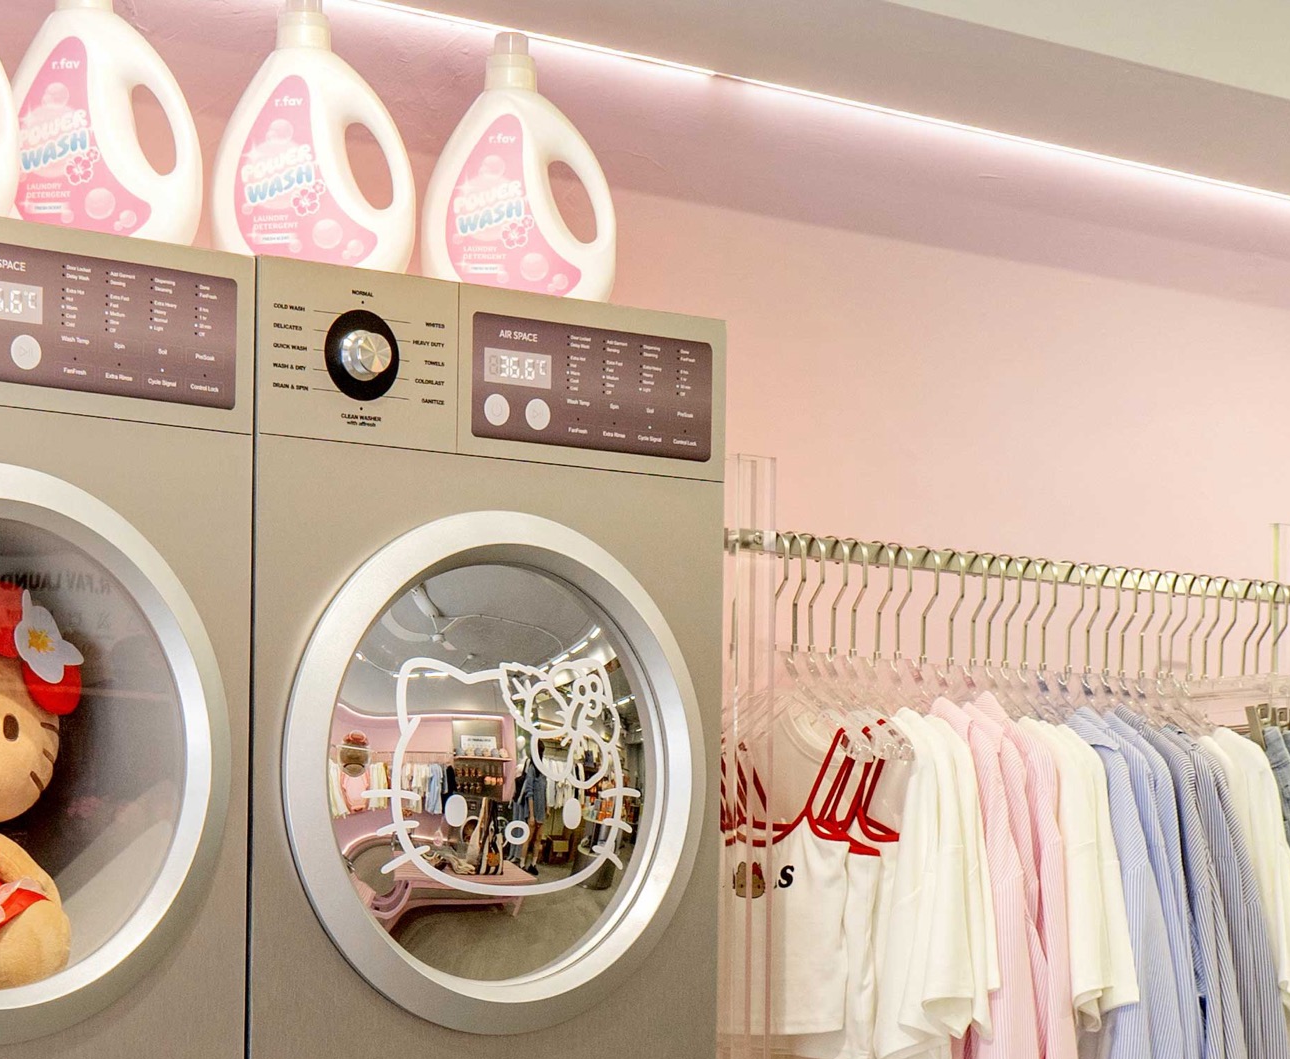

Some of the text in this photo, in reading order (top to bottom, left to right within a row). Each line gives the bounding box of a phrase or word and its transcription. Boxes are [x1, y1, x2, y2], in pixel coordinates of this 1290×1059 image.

[51, 58, 81, 70] r.fav
[274, 96, 303, 107] r.fav
[489, 133, 516, 144] r.fav
[21, 130, 87, 170] WASH
[241, 144, 313, 183] POWER
[247, 165, 313, 203] WASH
[26, 191, 71, 199] DETERGENT
[454, 181, 523, 214] POWER
[253, 215, 288, 223] LAUNDRY
[458, 201, 523, 234] WASH
[253, 222, 299, 230] DETERGENT
[61, 334, 90, 345] Wash Temp
[498, 329, 538, 343] AIR SPACE
[113, 341, 125, 350] Spin
[157, 347, 167, 355] Soil
[63, 366, 87, 376] FanFresh
[104, 372, 133, 382] Extra Rinse
[147, 377, 177, 388] Cycle Signal
[189, 383, 219, 393] Control Lock
